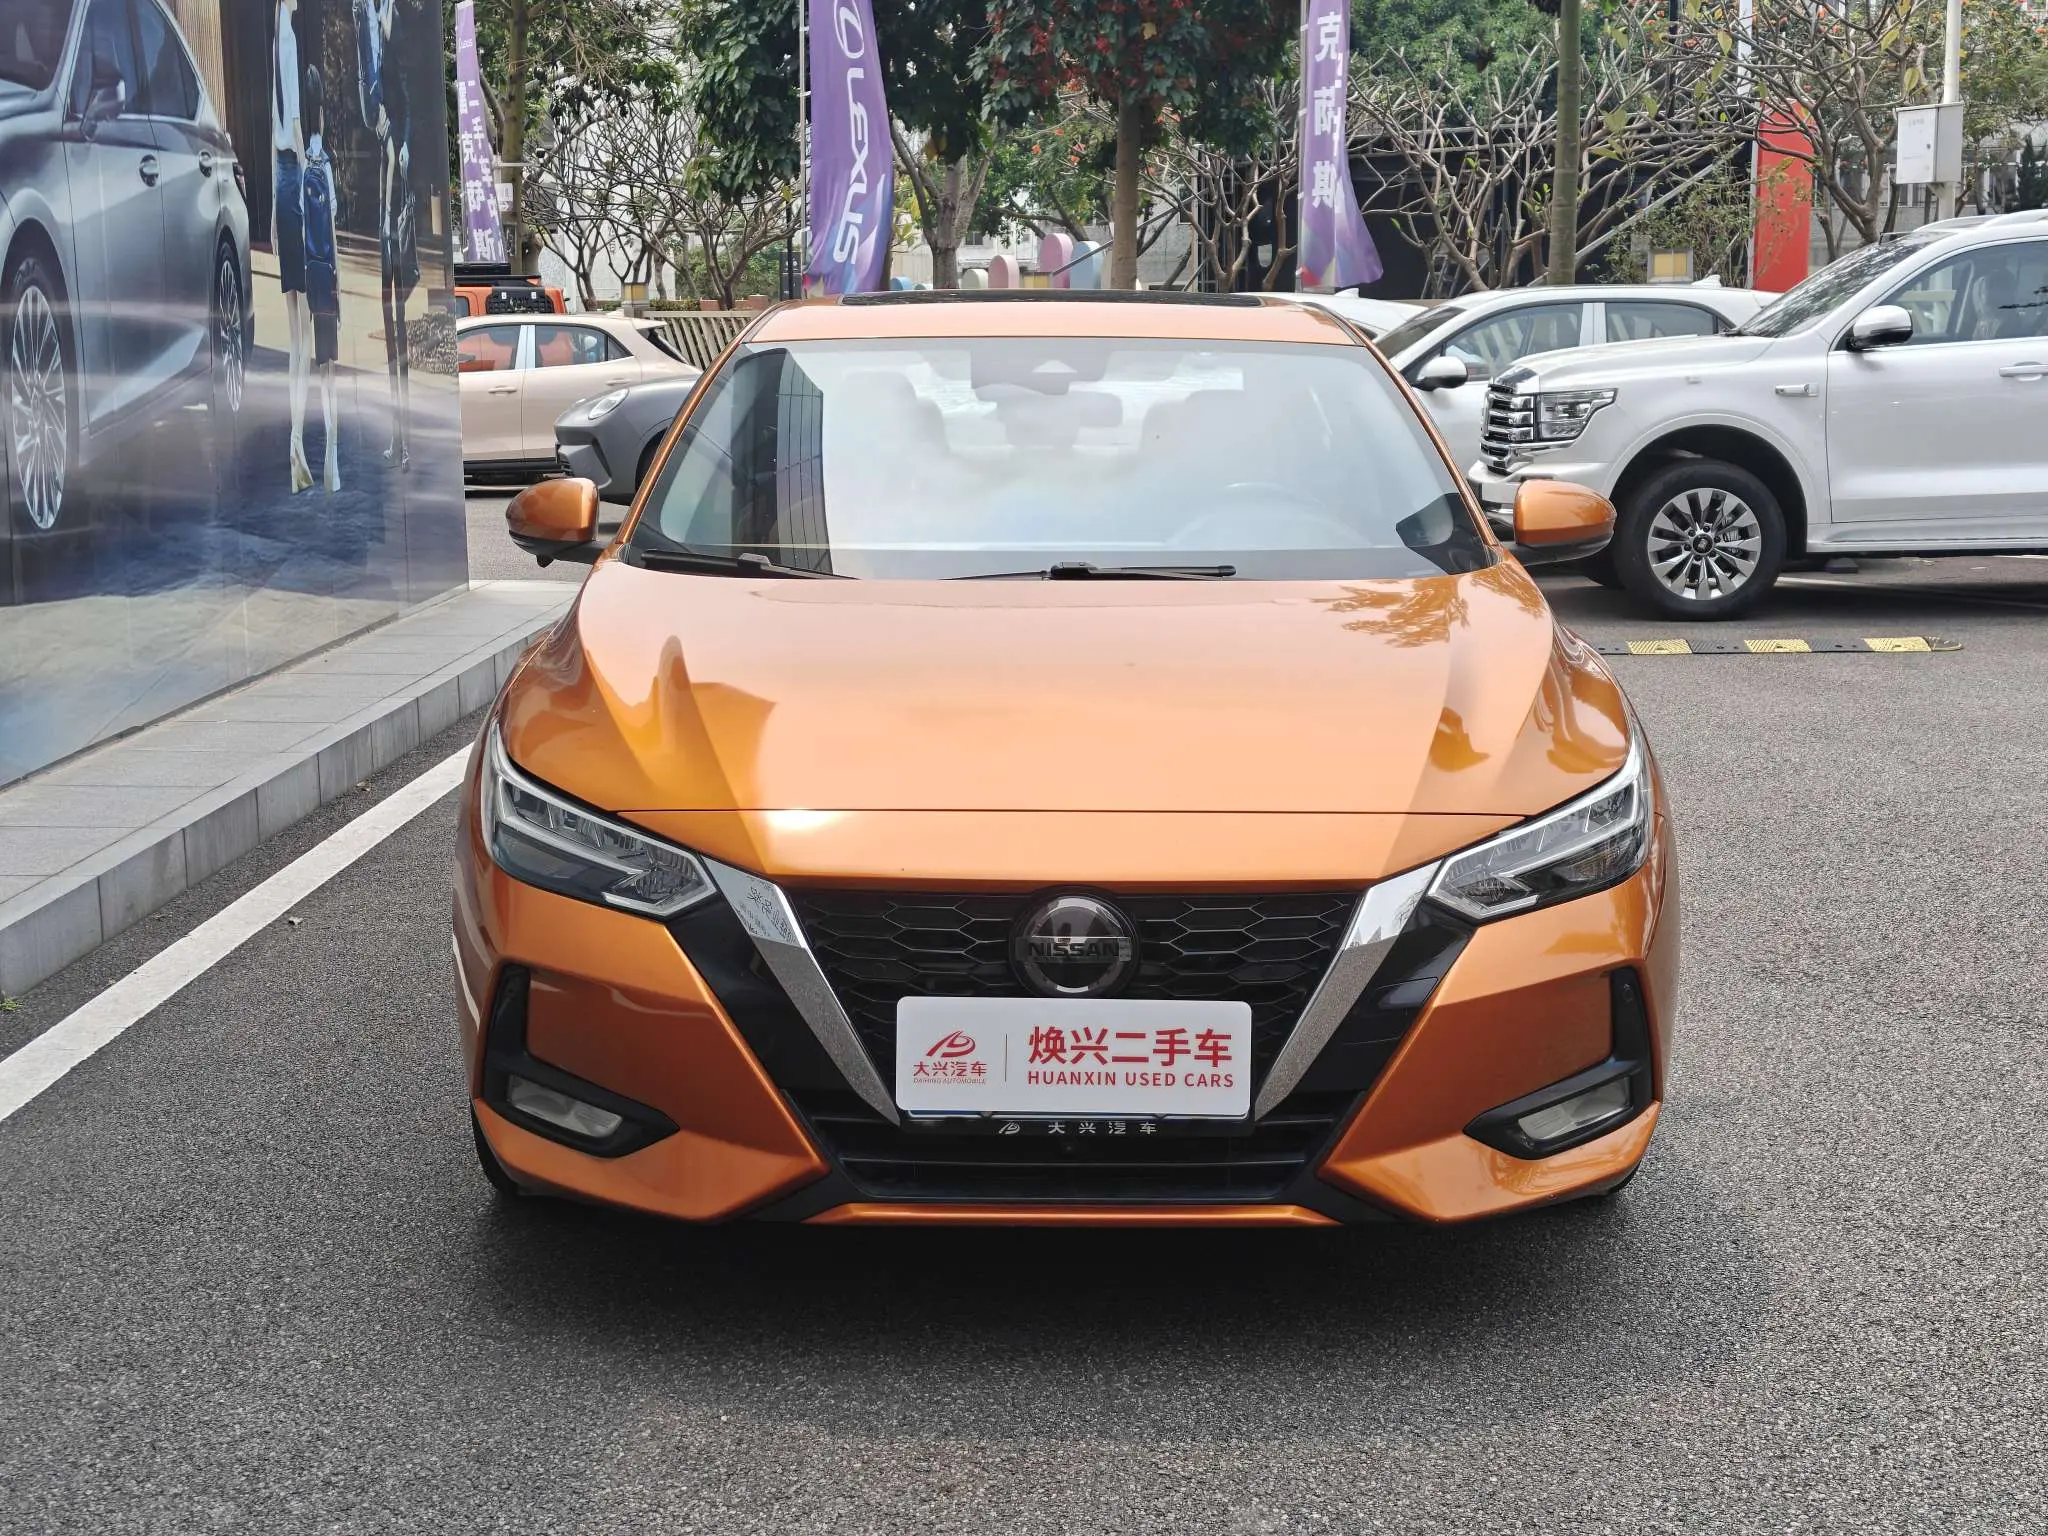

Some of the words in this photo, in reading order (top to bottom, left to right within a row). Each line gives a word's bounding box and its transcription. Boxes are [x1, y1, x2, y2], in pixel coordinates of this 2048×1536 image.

[833, 67, 868, 265] LEXUS
[1028, 941, 1120, 957] NISSAN
[1028, 1026, 1233, 1068] 焕兴二手车
[913, 1061, 988, 1077] 大兴汽车
[1028, 1071, 1117, 1087] HUANXIN
[1125, 1072, 1176, 1087] USED
[1184, 1073, 1234, 1088] CARS
[1048, 1121, 1157, 1135] 大兴汽车
